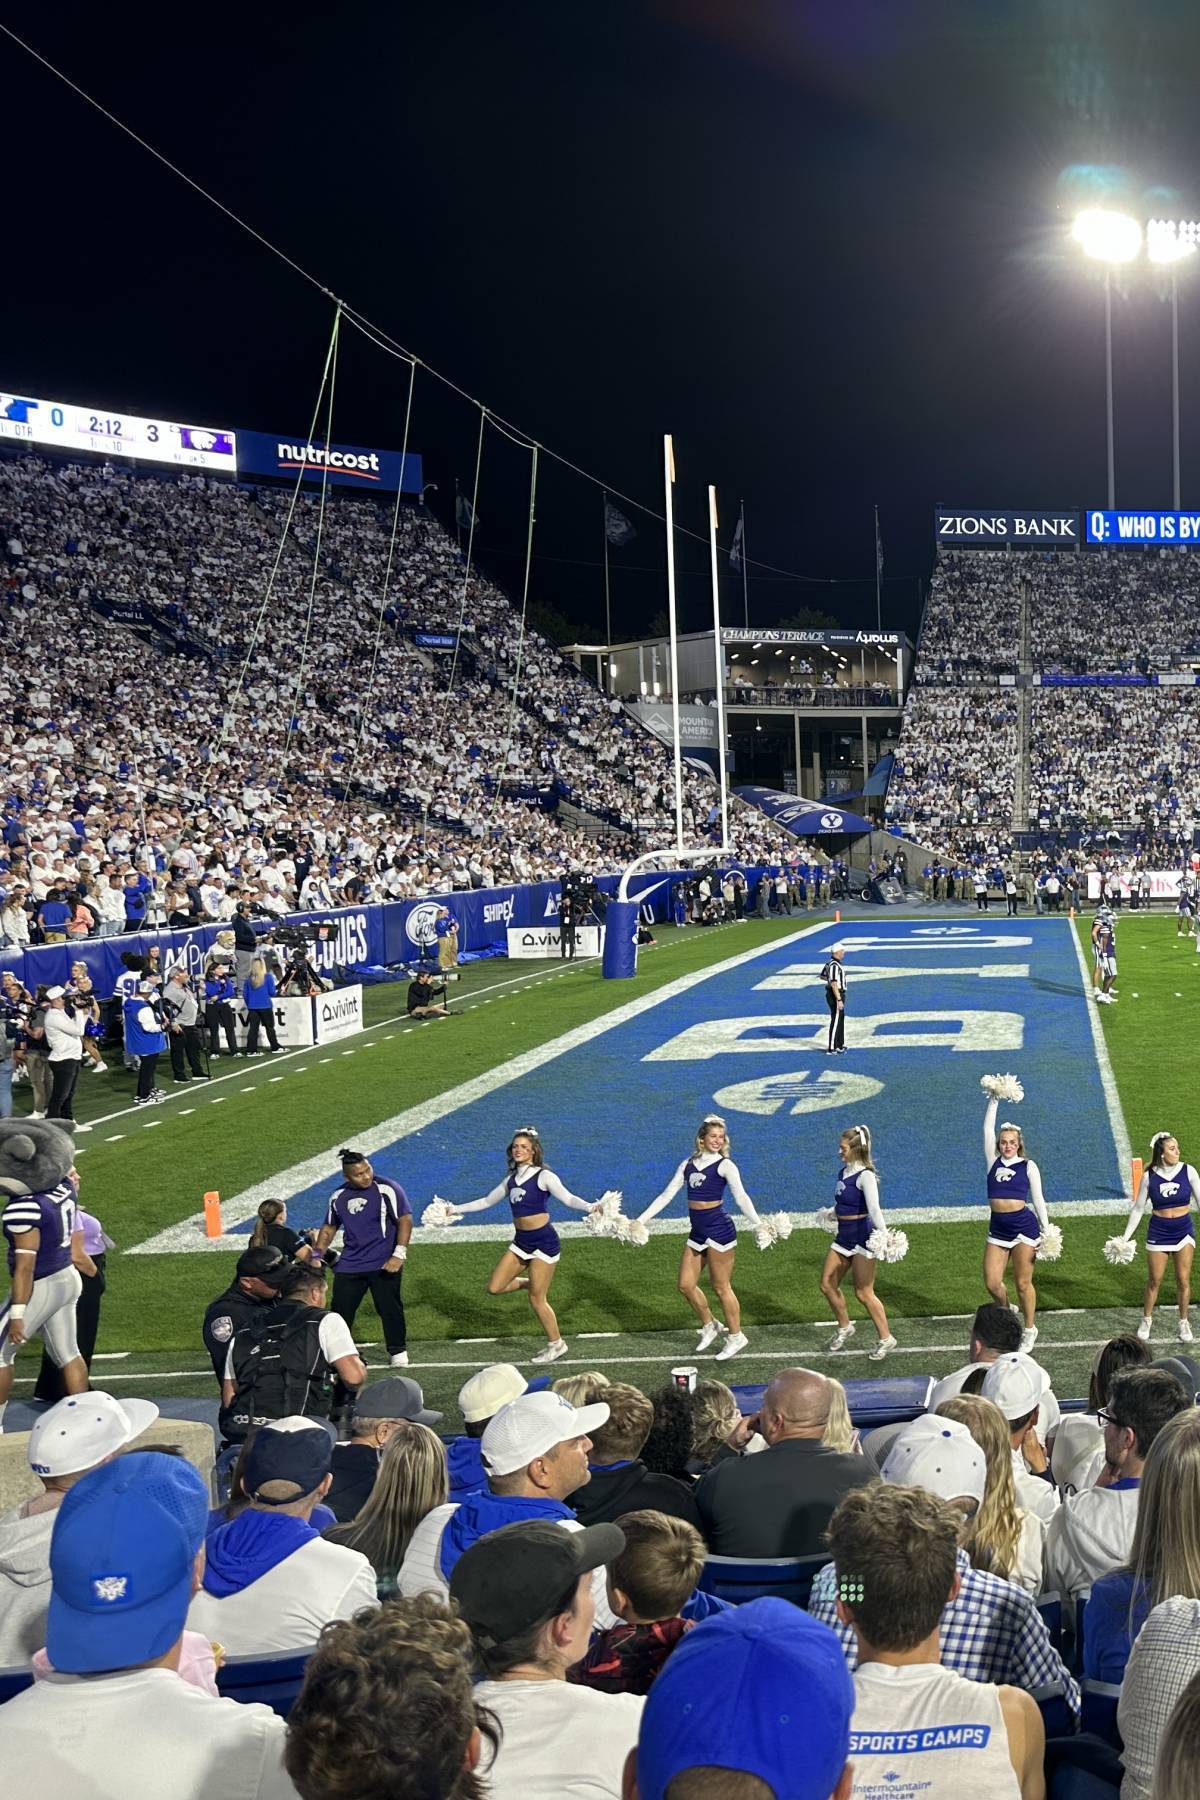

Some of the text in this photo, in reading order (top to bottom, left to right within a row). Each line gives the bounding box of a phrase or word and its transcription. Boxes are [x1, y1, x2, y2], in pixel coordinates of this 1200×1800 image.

[51, 408, 63, 427] 0
[90, 416, 122, 437] 2:12
[147, 424, 159, 442] 3
[278, 443, 380, 471] nutricost
[939, 516, 1076, 537] ZIONS BANK
[1091, 512, 1110, 542] Q:
[1118, 516, 1156, 539] WHO
[1160, 516, 1176, 539] IS
[722, 629, 779, 641] CHAMPIONS
[780, 630, 825, 642] TERRACE
[849, 1728, 985, 1751] SPORTS CAMPS
